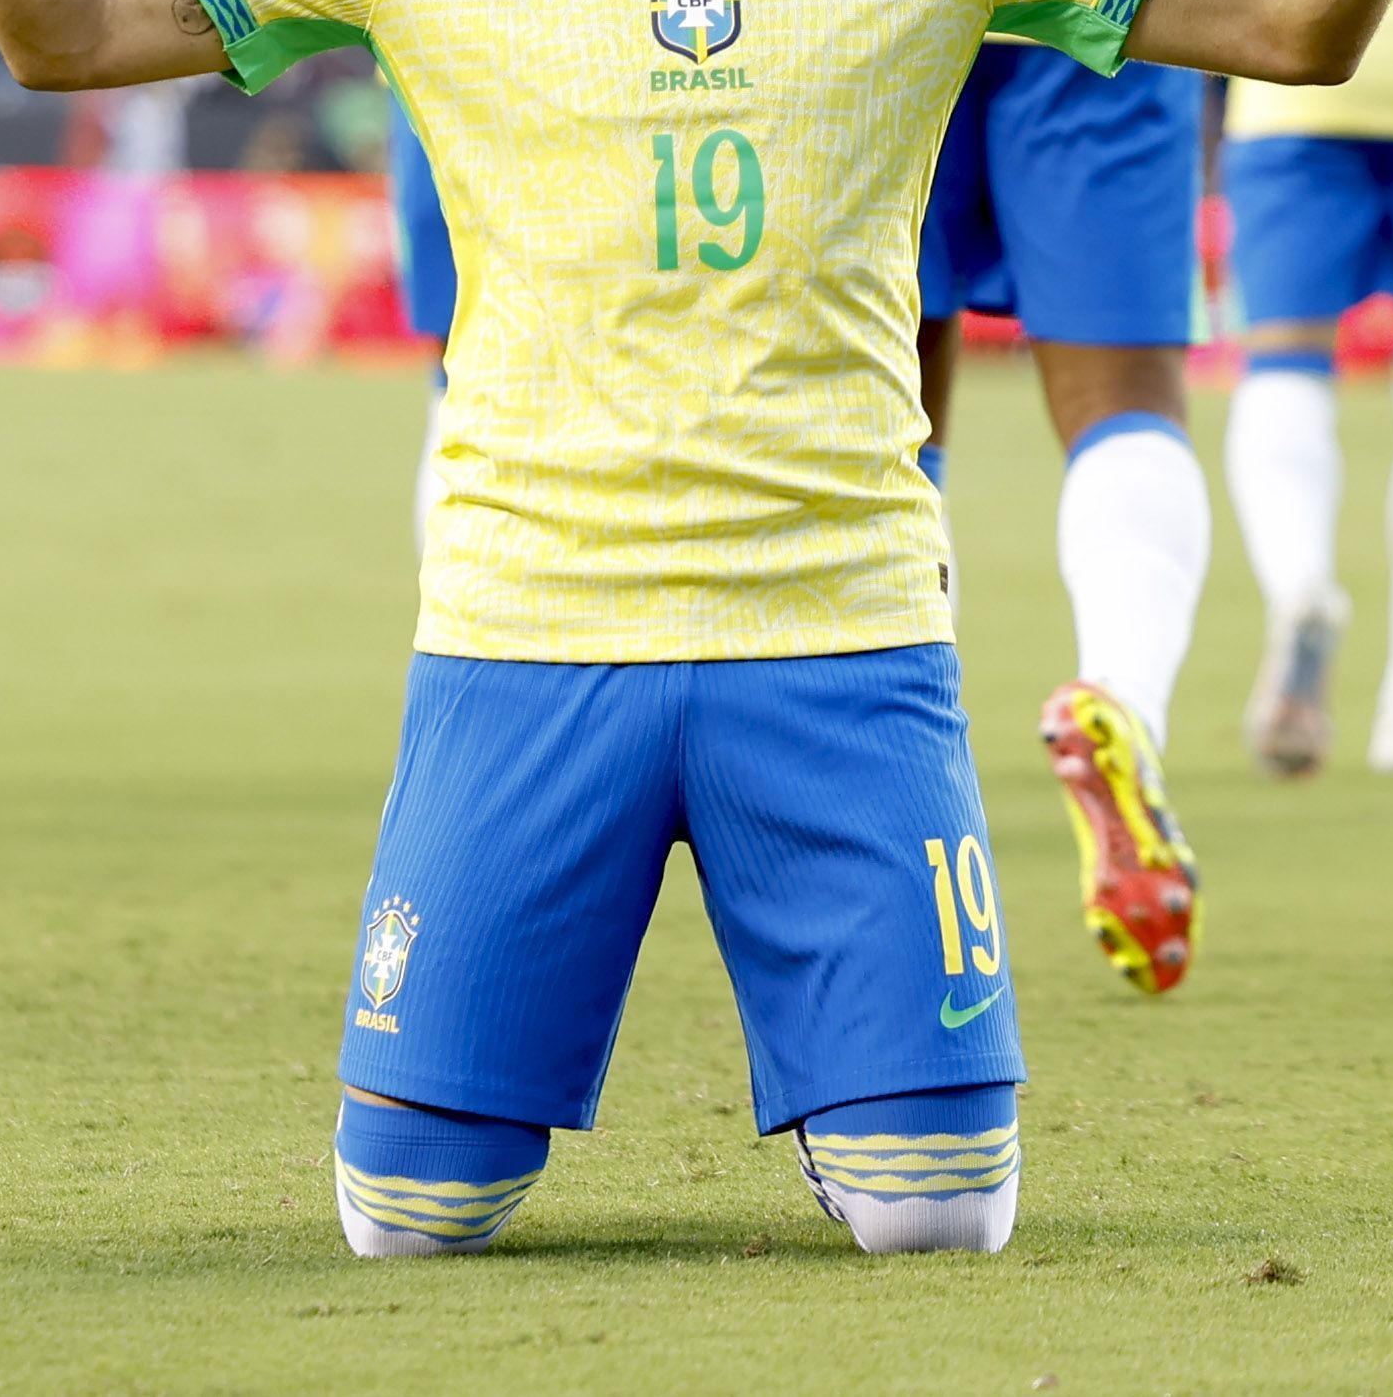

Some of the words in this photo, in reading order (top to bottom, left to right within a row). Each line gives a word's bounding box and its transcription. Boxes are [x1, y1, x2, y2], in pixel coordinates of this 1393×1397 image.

[650, 67, 754, 92] BRASIL
[652, 129, 766, 272] 19
[924, 835, 1000, 976] 19
[377, 950, 393, 961] CBF
[356, 1009, 399, 1033] BRASIL
